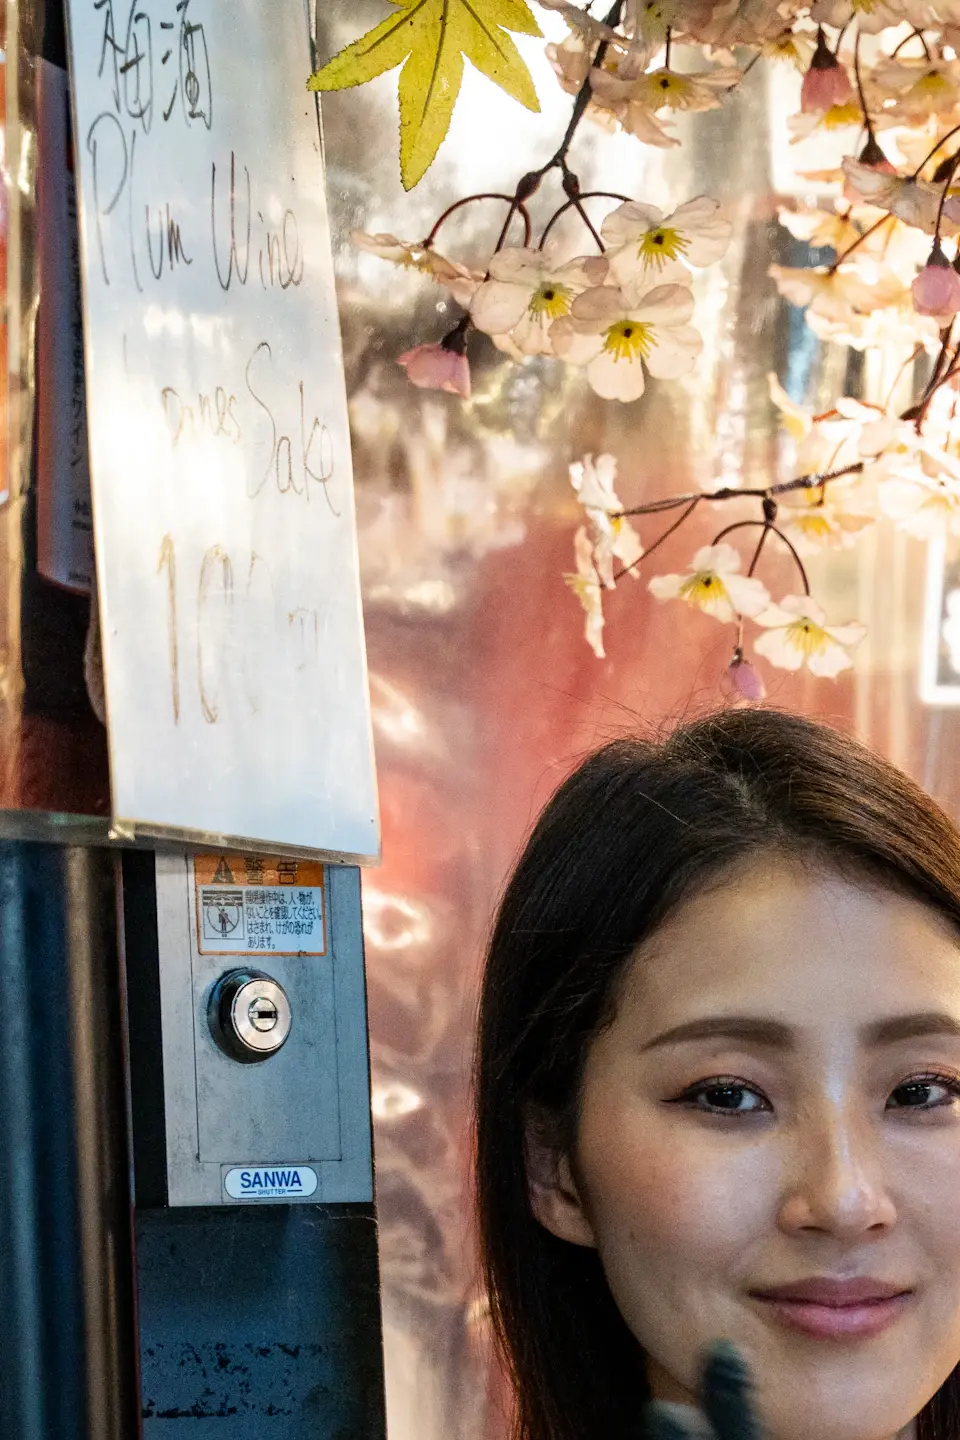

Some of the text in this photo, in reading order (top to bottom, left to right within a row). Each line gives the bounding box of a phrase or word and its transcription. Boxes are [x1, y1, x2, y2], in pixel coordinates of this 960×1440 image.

[87, 112, 193, 293] Plum
[211, 150, 304, 290] Wine
[245, 341, 341, 517] Sake
[243, 856, 298, 885] 警告
[240, 1170, 303, 1189] SANWA
[257, 1188, 287, 1196] SHUTTER
